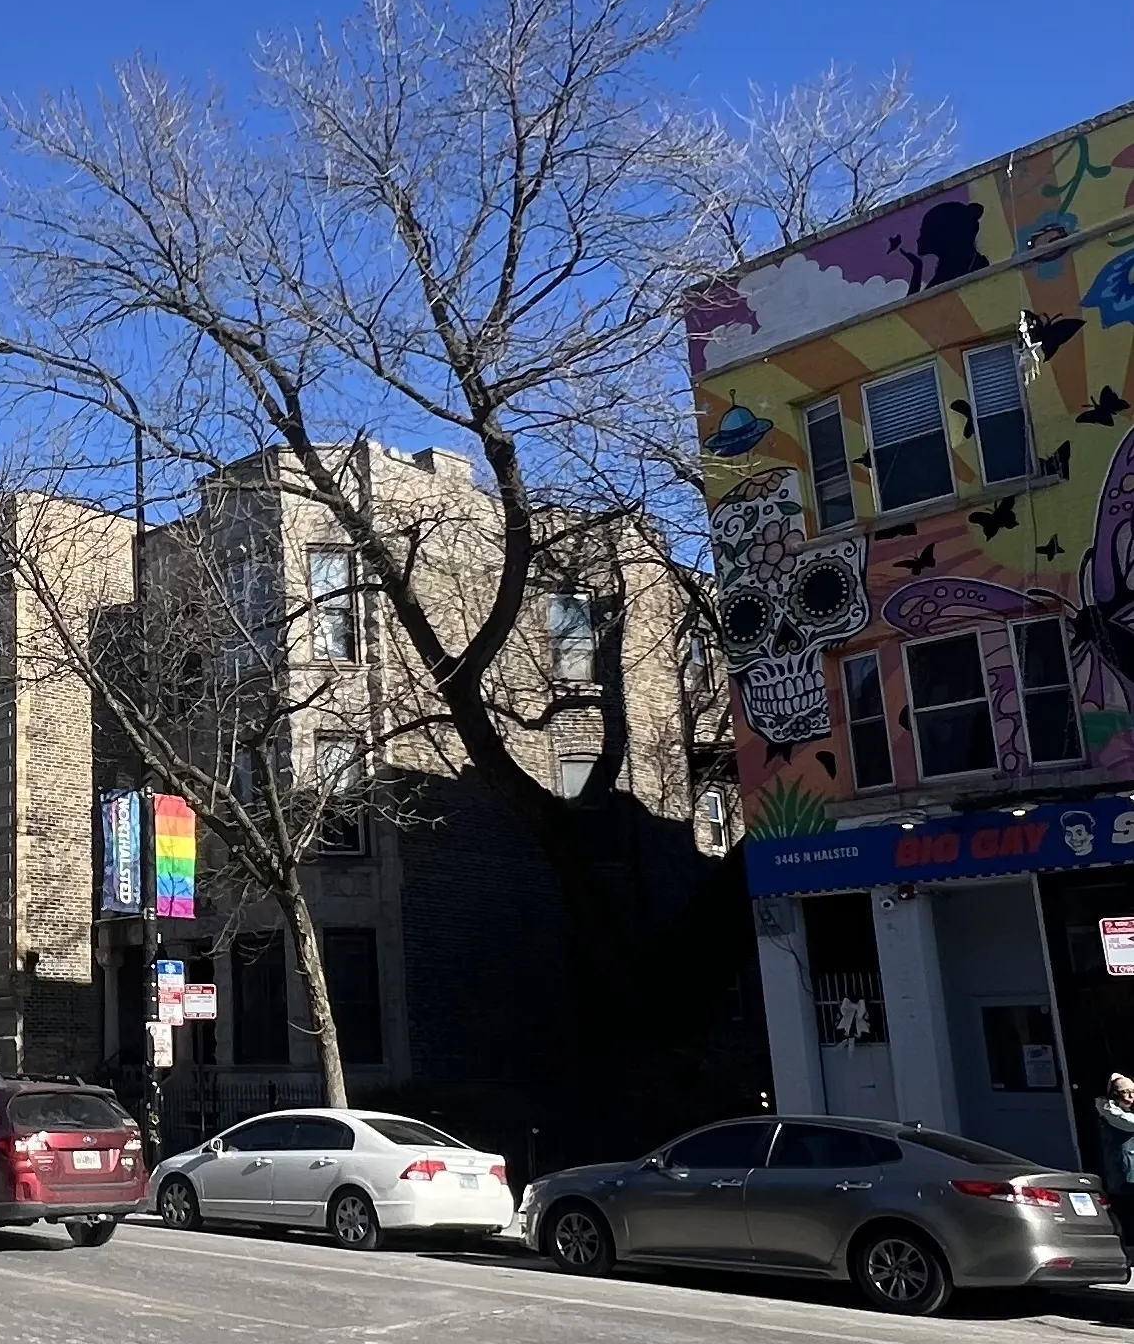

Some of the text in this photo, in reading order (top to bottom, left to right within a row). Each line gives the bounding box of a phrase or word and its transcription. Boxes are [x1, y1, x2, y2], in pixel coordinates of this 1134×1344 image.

[117, 797, 132, 905] NORTHALSTED
[774, 853, 801, 866] 3445
[813, 846, 859, 862] HALSTED
[895, 832, 961, 869] BIG
[971, 821, 1051, 860] GAY
